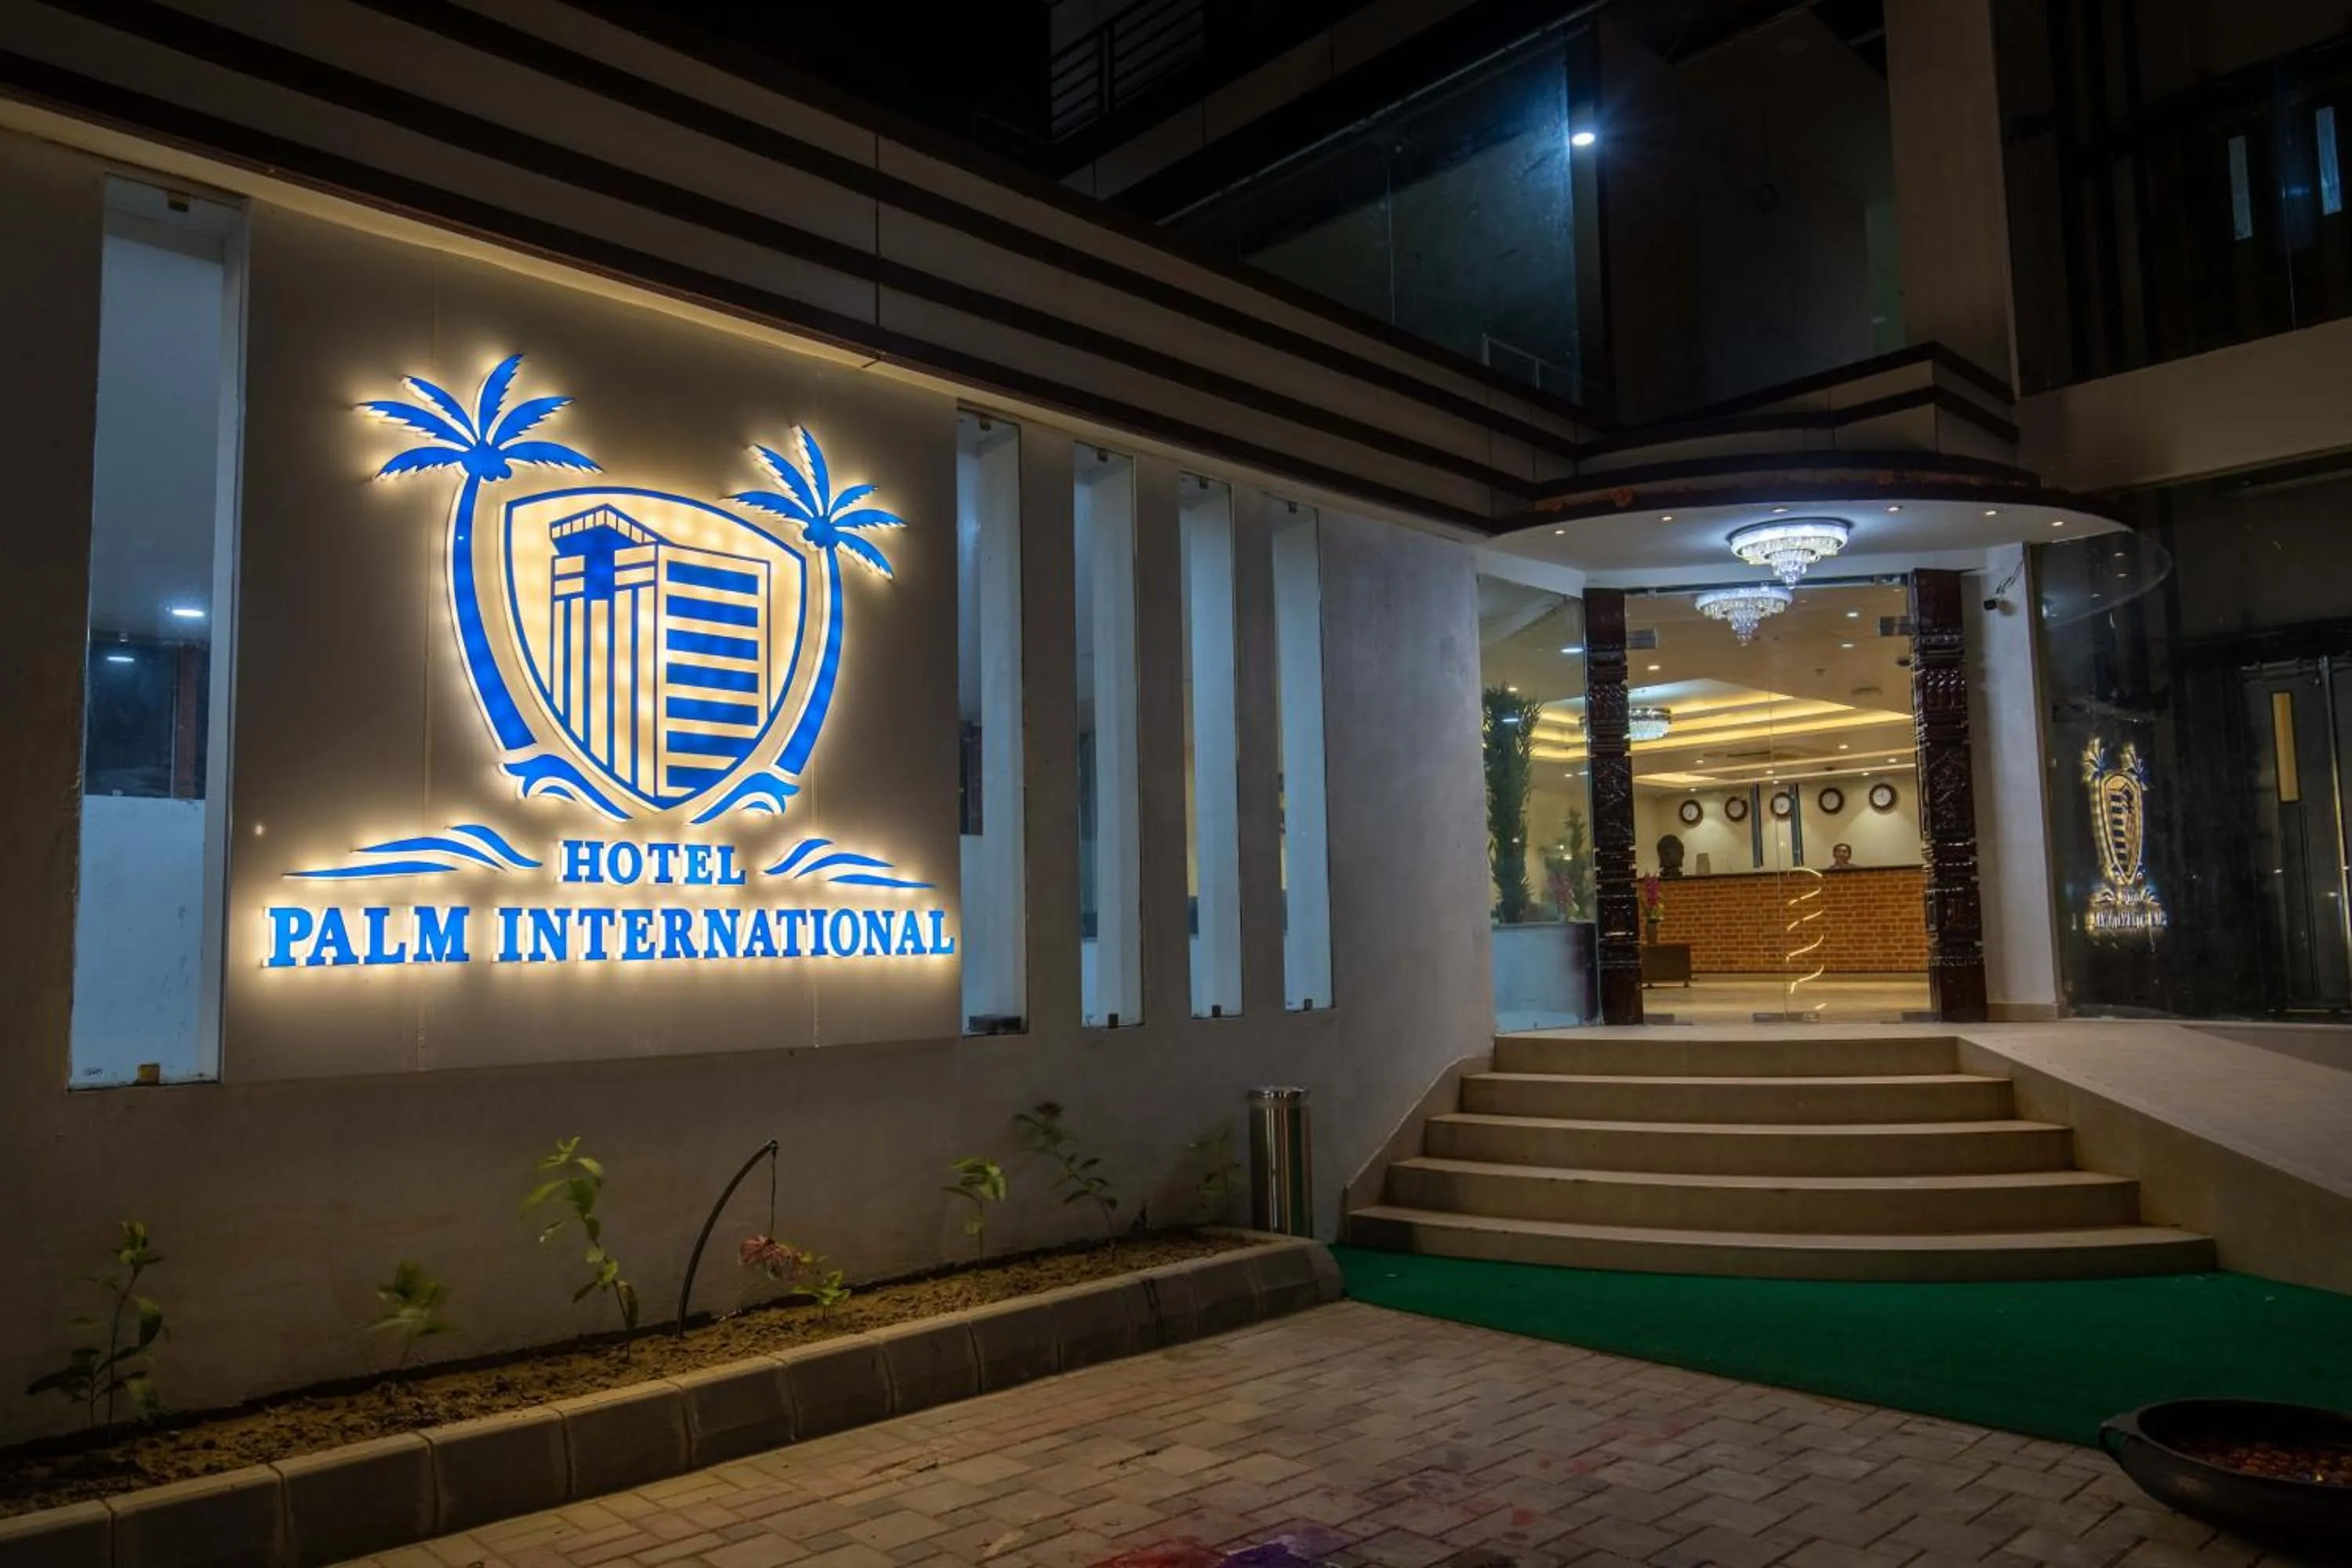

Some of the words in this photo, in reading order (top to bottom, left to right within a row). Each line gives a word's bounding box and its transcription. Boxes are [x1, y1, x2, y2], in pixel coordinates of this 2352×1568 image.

[561, 839, 746, 886] HOTEL
[264, 906, 470, 967] PALM
[495, 906, 955, 963] INTERNATIONAL
